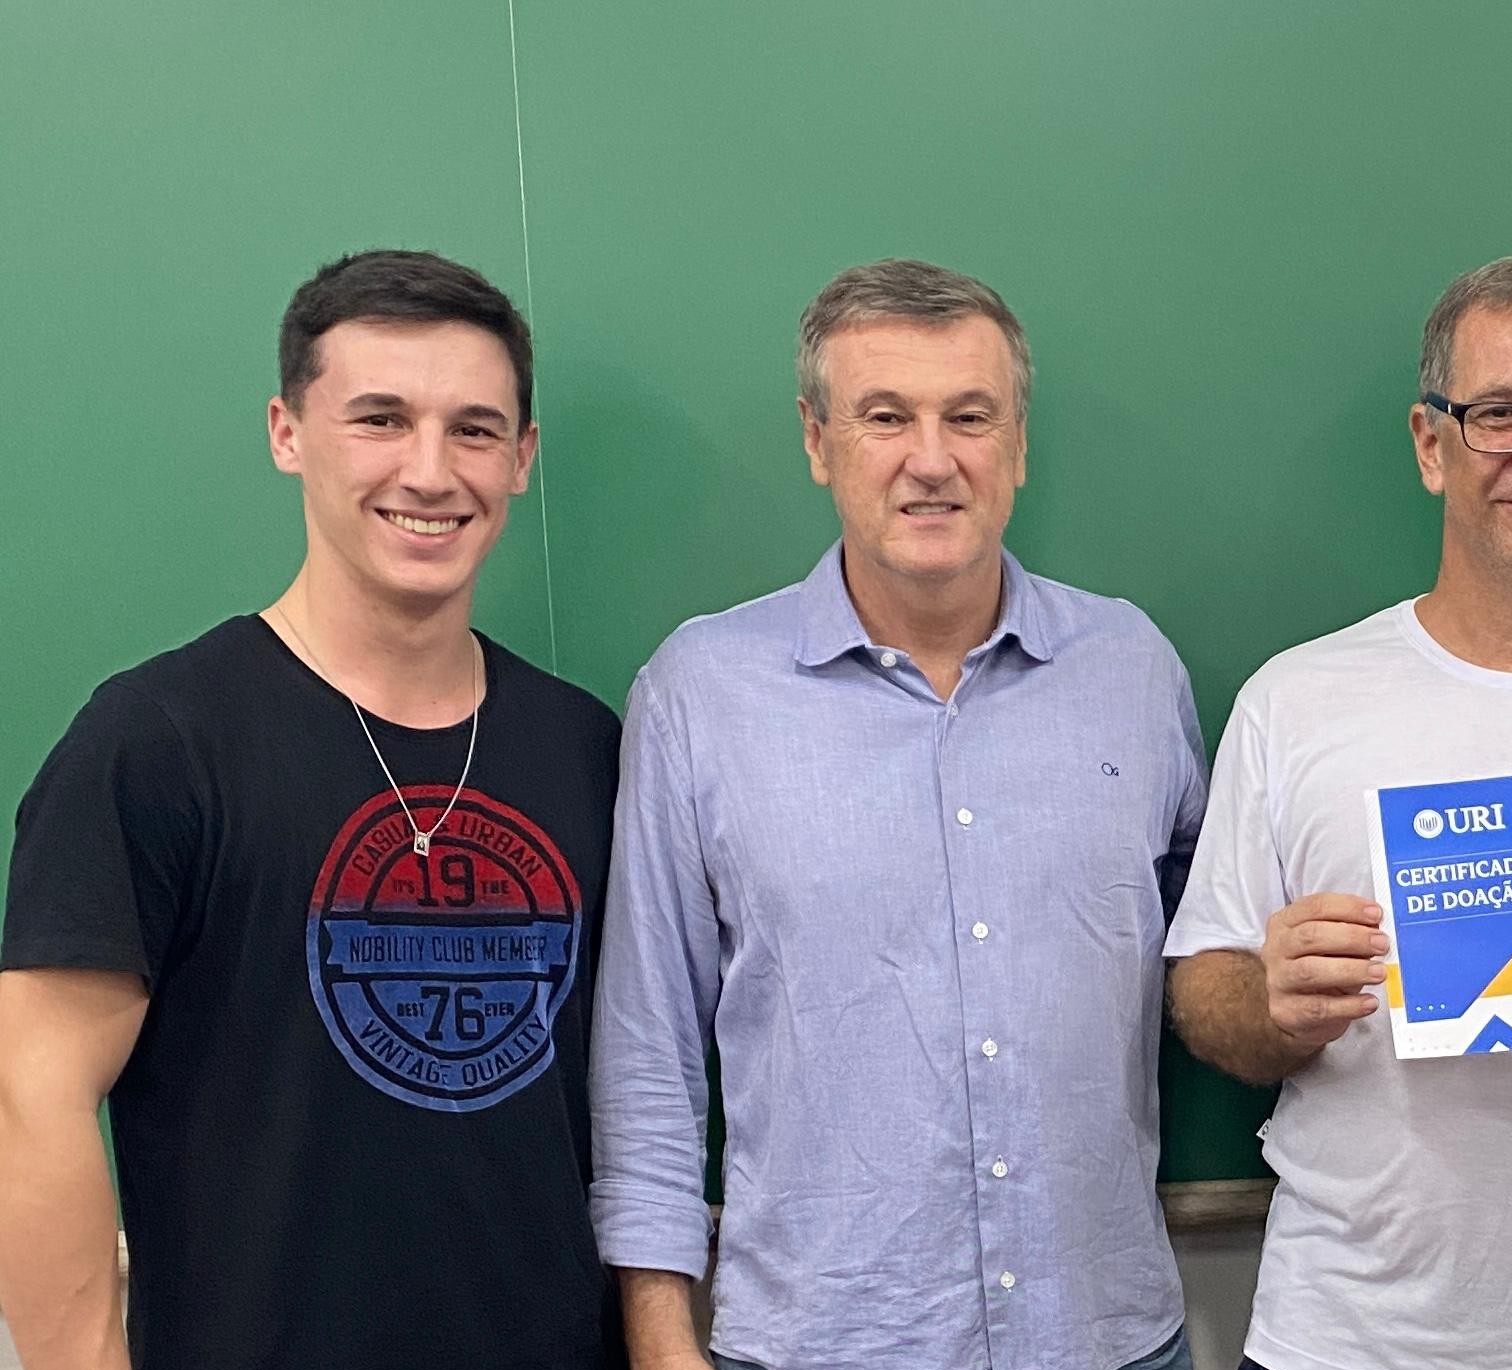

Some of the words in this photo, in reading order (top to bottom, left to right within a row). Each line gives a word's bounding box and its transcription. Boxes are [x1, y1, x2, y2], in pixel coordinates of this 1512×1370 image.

[352, 811, 418, 876] CASUA
[460, 815, 542, 878] URBAN
[1444, 803, 1506, 833] URI
[417, 854, 475, 907] 19
[481, 880, 509, 895] THE
[1406, 894, 1437, 913] DE
[350, 935, 424, 963] NOBILITY
[432, 936, 474, 963] CLUB
[397, 1002, 425, 1017] BEST
[421, 986, 485, 1041] 76
[484, 1002, 515, 1017] EVER
[462, 1013, 546, 1086] QUALITY
